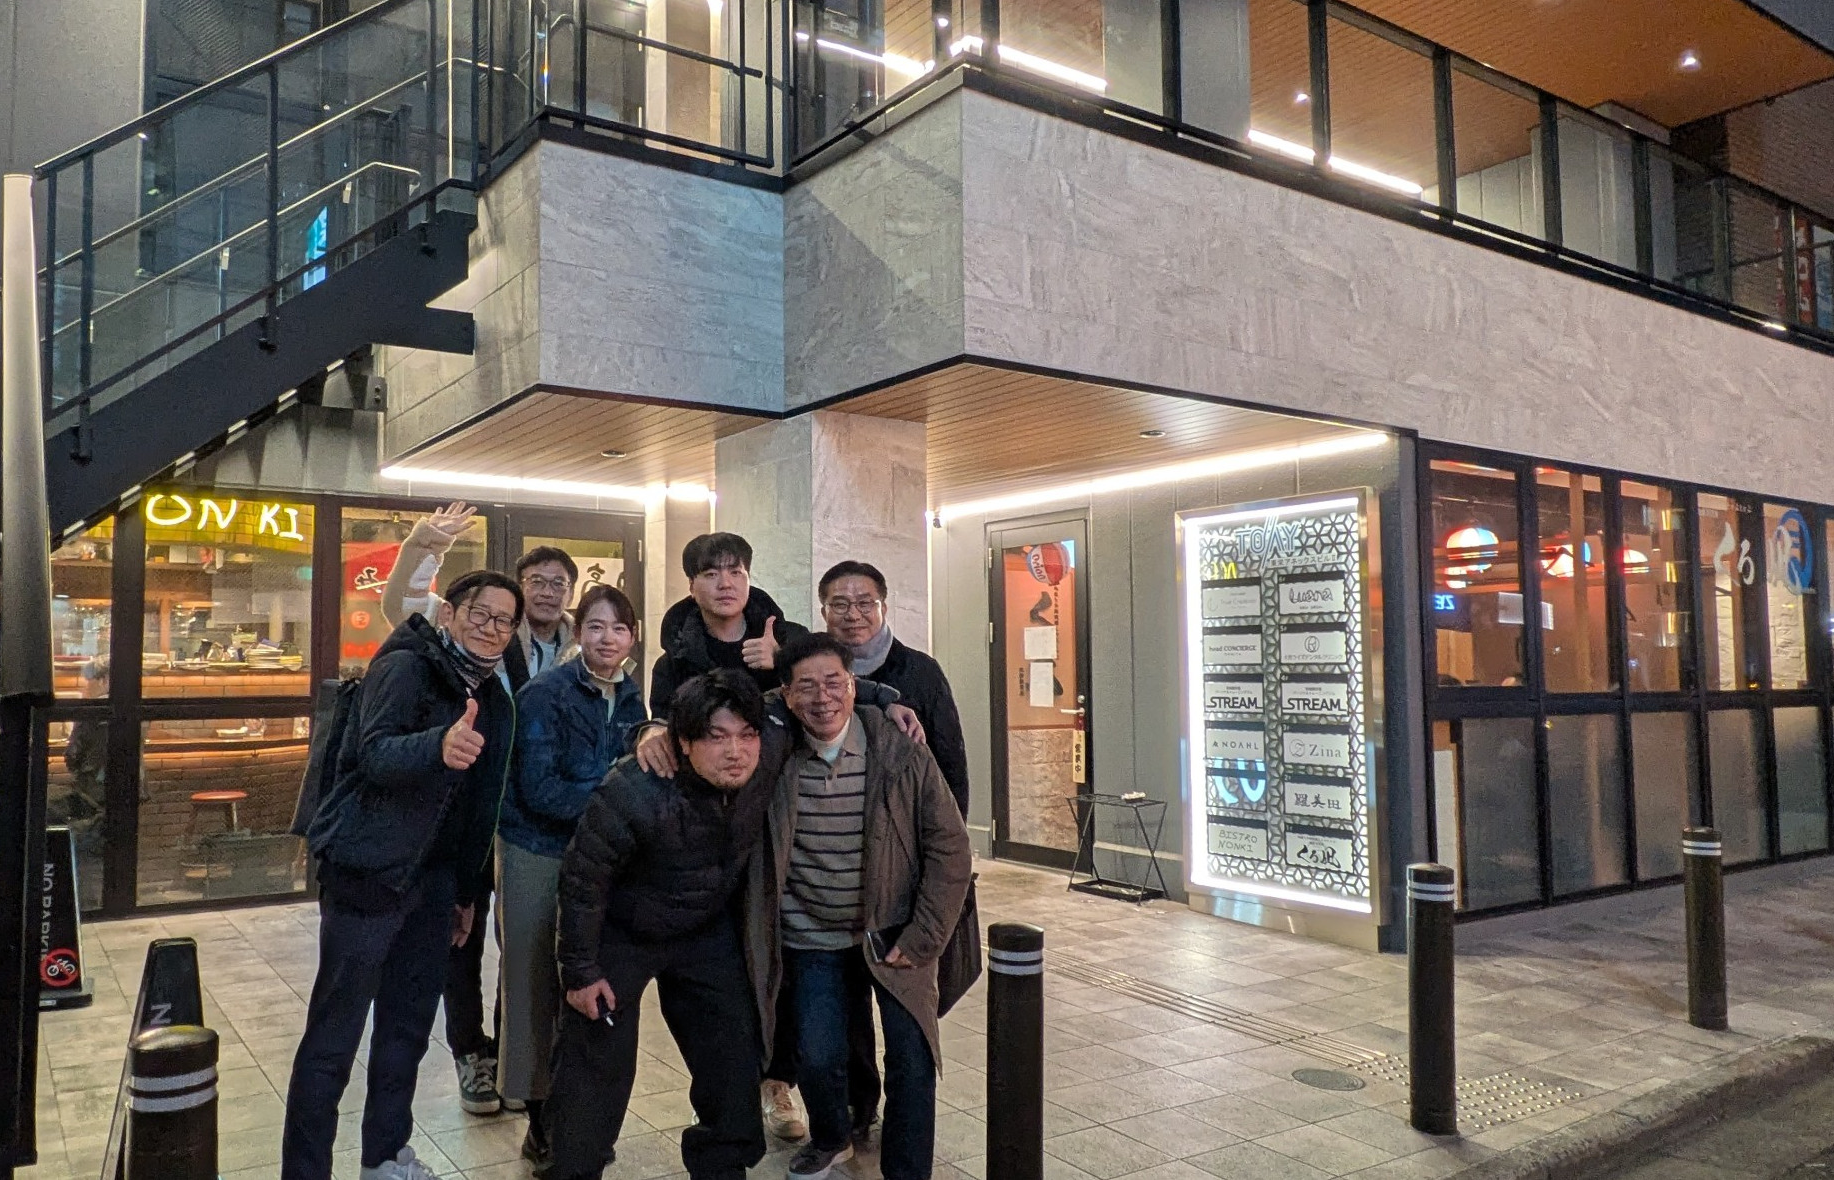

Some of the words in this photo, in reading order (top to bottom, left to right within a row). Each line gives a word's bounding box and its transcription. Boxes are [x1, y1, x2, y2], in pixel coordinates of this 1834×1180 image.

[1208, 696, 1259, 709] STREAM
[1285, 697, 1342, 711] STREAM
[1309, 744, 1342, 758] Zina
[1218, 829, 1258, 843] BISTRO
[1217, 840, 1254, 852] NONKI
